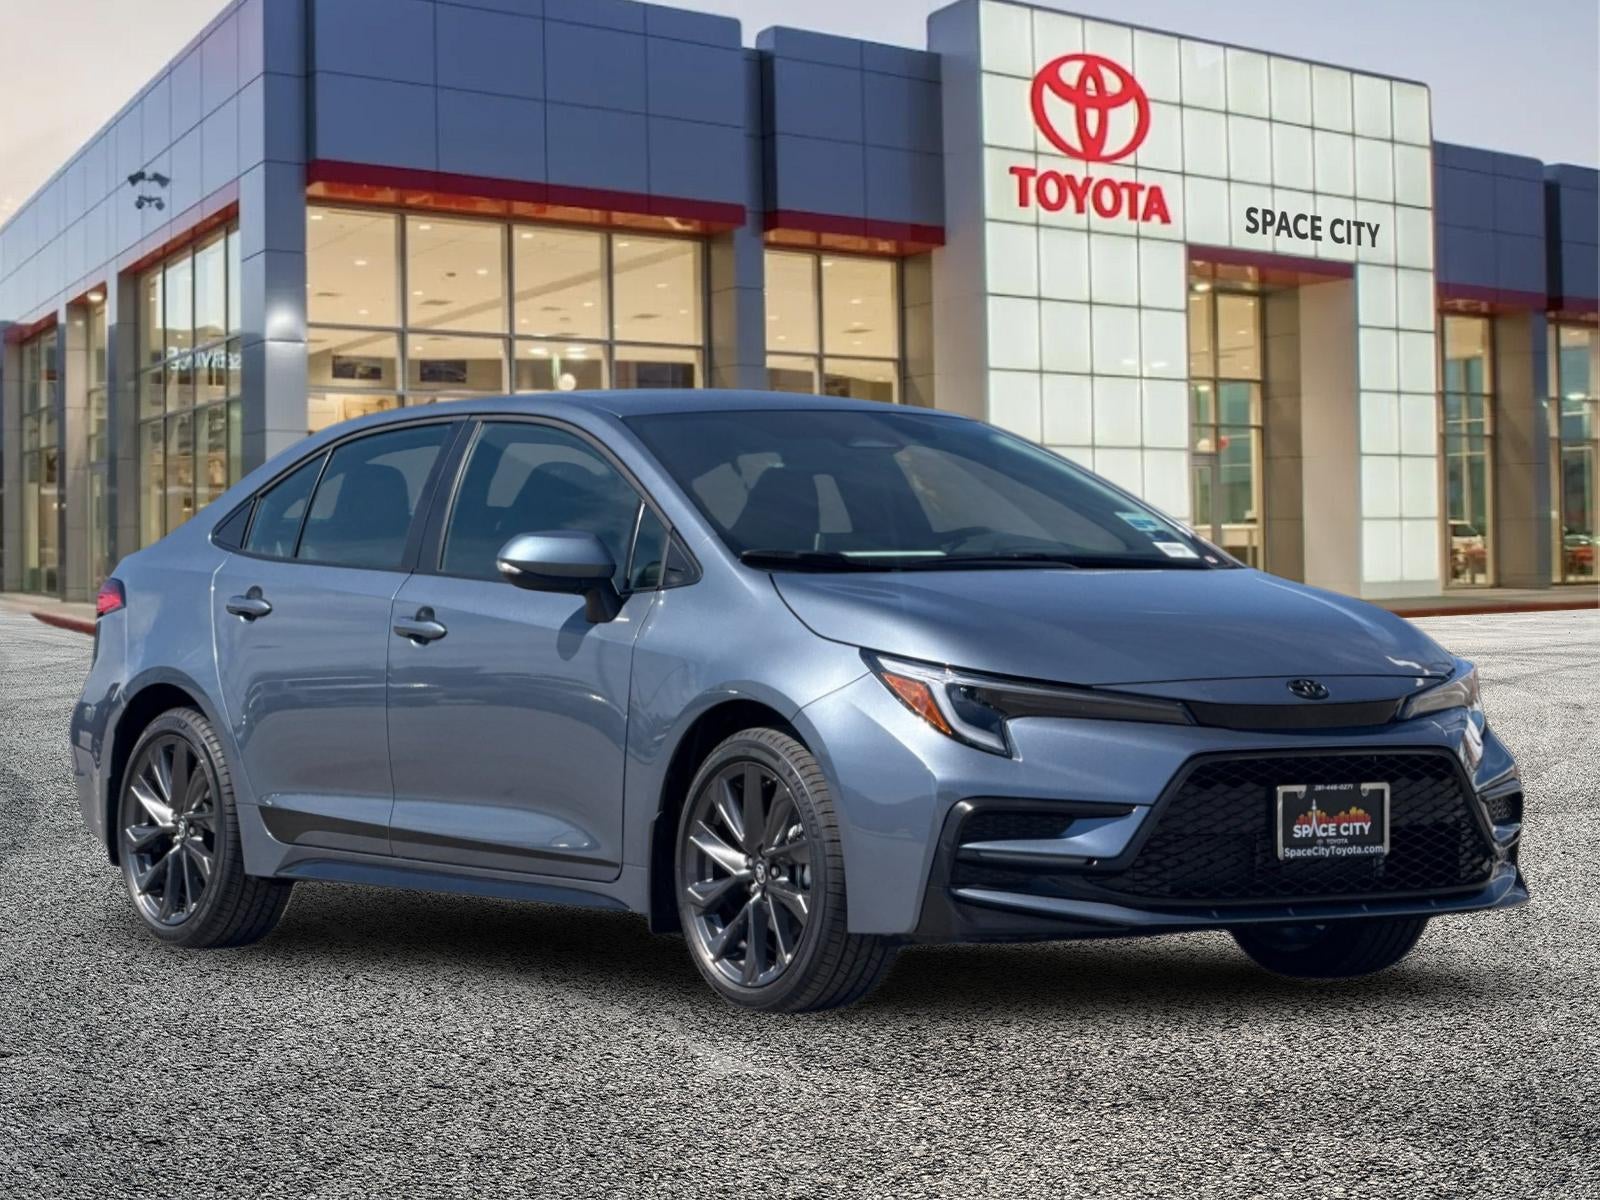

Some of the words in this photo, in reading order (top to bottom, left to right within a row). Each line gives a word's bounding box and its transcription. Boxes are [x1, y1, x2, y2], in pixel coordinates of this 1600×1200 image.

[1009, 167, 1171, 224] TOYOTA
[1245, 206, 1322, 242] SPACE
[1329, 218, 1380, 247] CITY
[1292, 820, 1337, 838] SPACE
[1340, 822, 1371, 837] CITY
[1284, 845, 1384, 858] SpaceCityToyota.com
